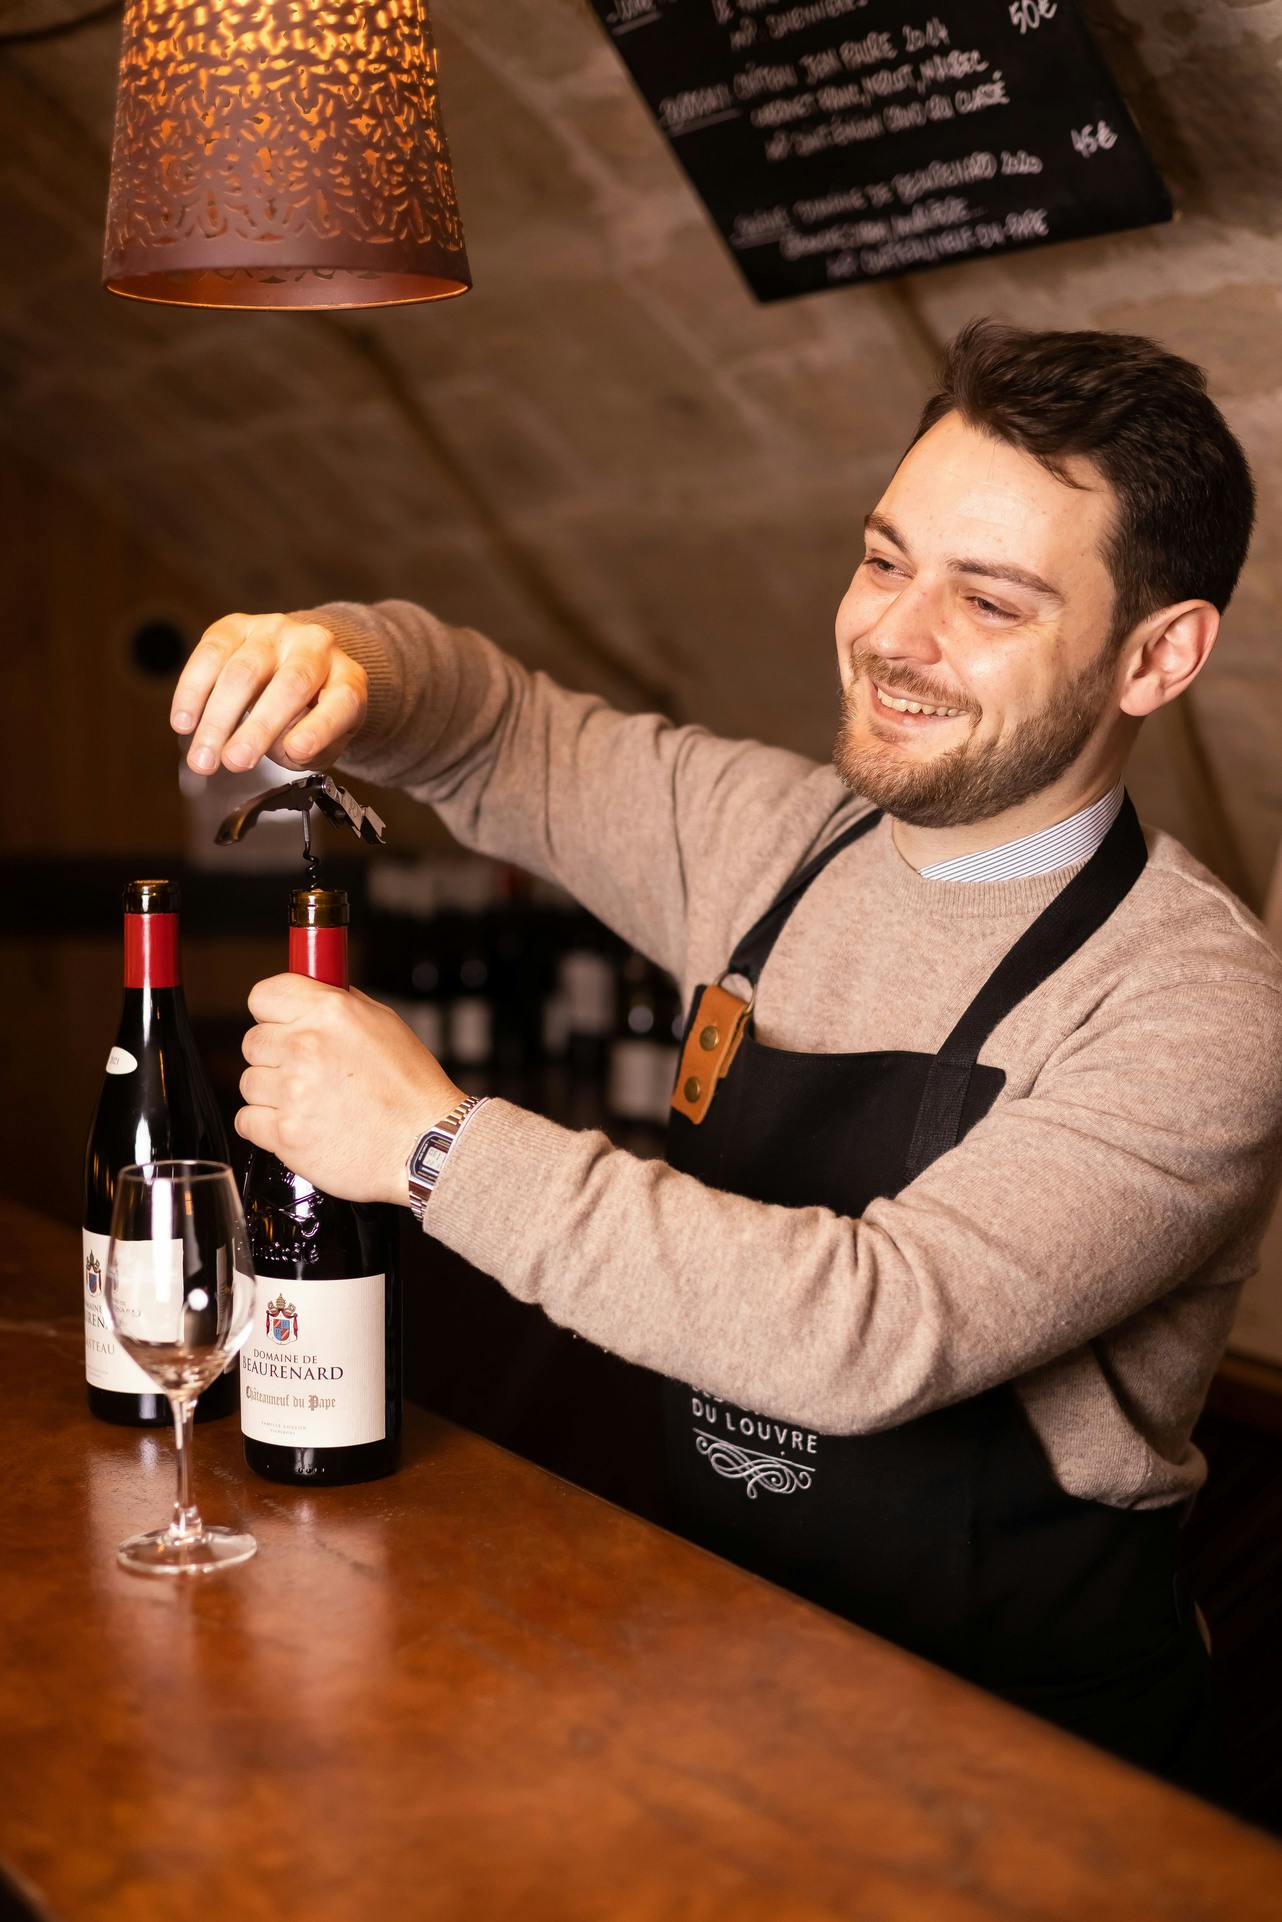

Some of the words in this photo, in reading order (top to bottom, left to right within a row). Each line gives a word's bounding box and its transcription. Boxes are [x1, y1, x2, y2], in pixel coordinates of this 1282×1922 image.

[1009, 0, 1058, 34] 50€
[1070, 120, 1119, 158] 45€
[242, 1356, 344, 1381] BEAURENARD
[253, 1348, 299, 1363] DOMAINE
[302, 1355, 318, 1364] DE
[292, 1395, 305, 1409] du
[308, 1394, 336, 1411] Pape
[691, 1397, 717, 1424] DU
[725, 1412, 818, 1454] LOUVRE
